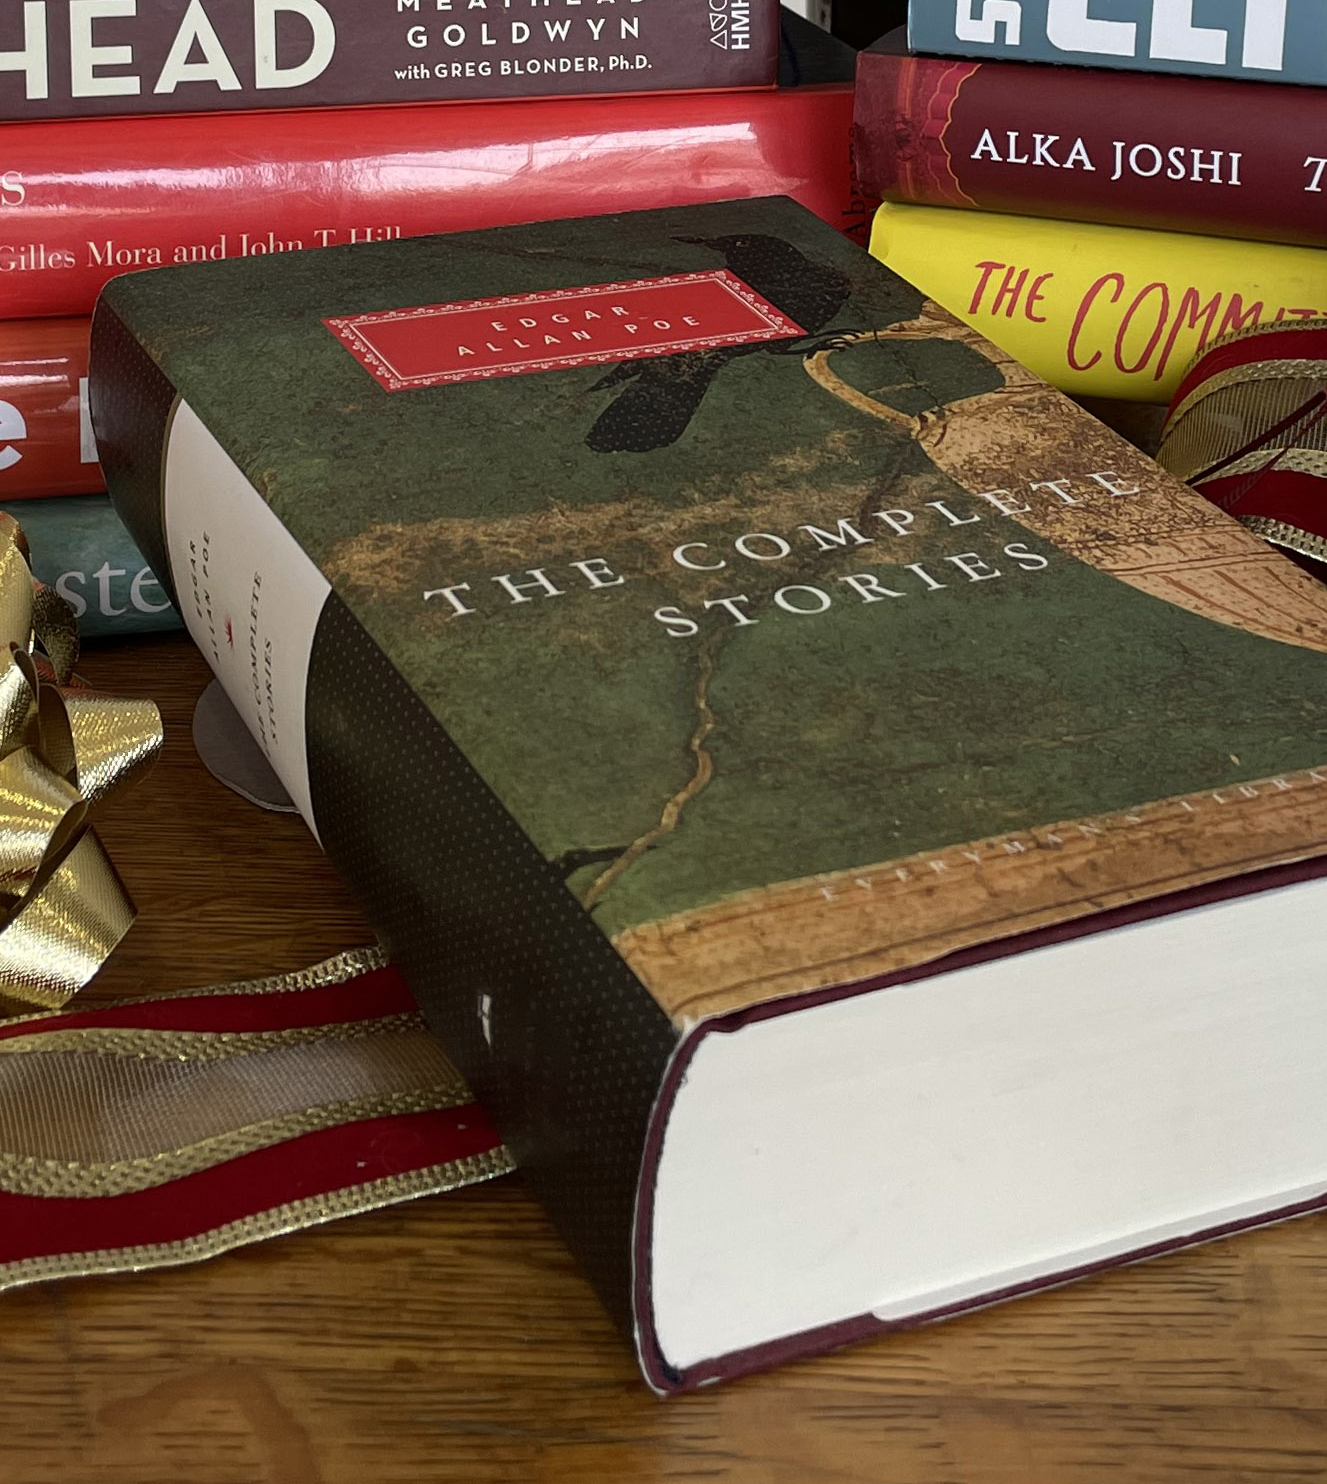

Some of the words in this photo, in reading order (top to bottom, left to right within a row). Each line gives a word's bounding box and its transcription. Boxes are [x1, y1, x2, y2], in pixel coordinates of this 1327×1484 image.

[406, 17, 640, 48] GOLDWYN
[394, 63, 431, 81] with
[434, 60, 493, 78] GREG
[500, 56, 605, 76] BLONDER,
[608, 54, 653, 71] Ph.D.
[971, 128, 1097, 173] ALKA
[1110, 139, 1242, 186] JOSHI
[86, 239, 162, 268] Mora
[172, 234, 227, 264] and
[239, 232, 303, 257] John
[968, 262, 1054, 324] THE
[456, 328, 591, 358] ALLAN
[625, 315, 701, 335] POE
[491, 304, 631, 333] EDGAR
[202, 531, 211, 578] POE
[423, 556, 625, 618] THE
[672, 470, 1141, 572] COMPLETE
[653, 542, 1049, 638] STORIES
[249, 571, 262, 706] COMPLETE
